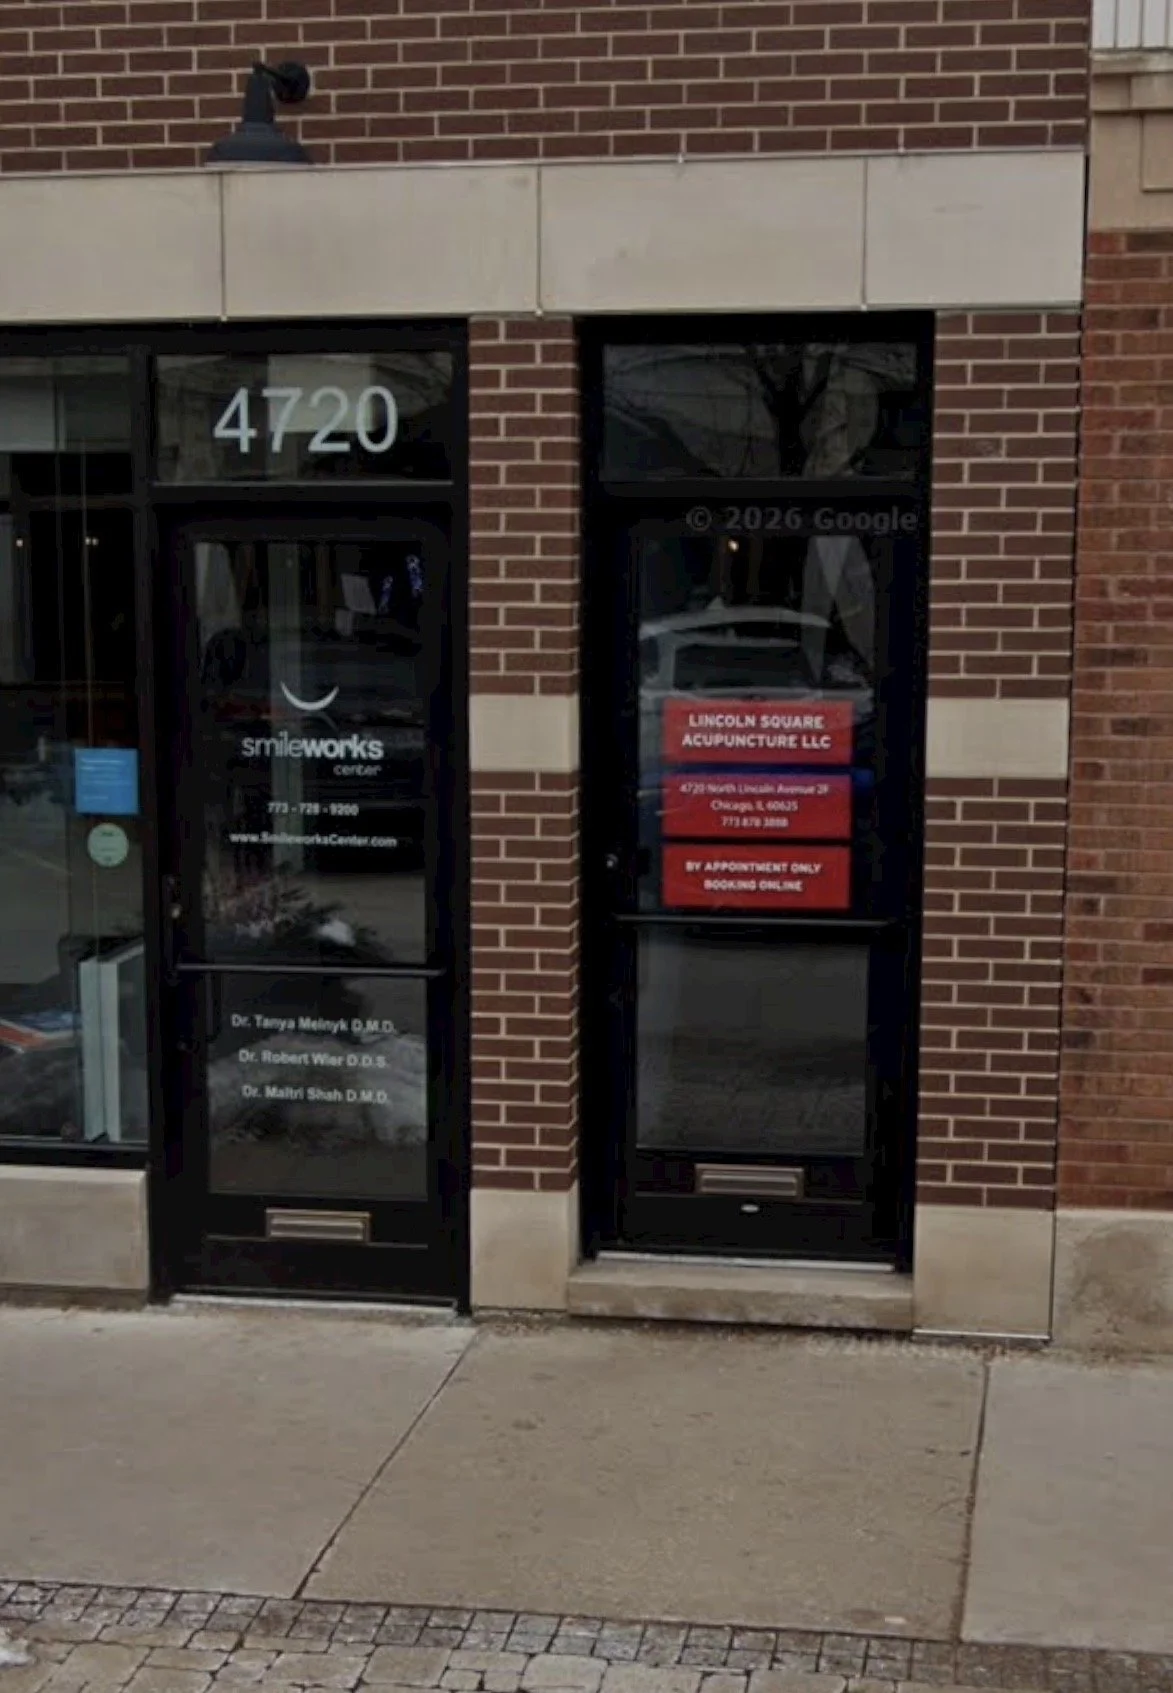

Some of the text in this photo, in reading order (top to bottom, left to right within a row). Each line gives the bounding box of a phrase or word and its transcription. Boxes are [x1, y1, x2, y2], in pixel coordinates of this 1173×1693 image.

[213, 385, 398, 453] 4720
[688, 713, 825, 730] LINCOLN SQUARE
[241, 731, 384, 760] smileworks
[682, 733, 832, 749] ACUPUNCTURE LLC
[333, 764, 382, 777] center
[706, 783, 736, 795] North
[739, 783, 775, 795] Lincoln
[777, 783, 814, 795] Avenue
[685, 861, 822, 875] BY APPOINTMENT ONLY
[703, 879, 803, 892] BOOKING ONLINE
[231, 1014, 251, 1028] Dr.
[255, 1014, 295, 1032] Tanya
[238, 1049, 258, 1063] Dr.
[261, 1050, 309, 1065] Robert
[241, 1085, 261, 1098] Dr.
